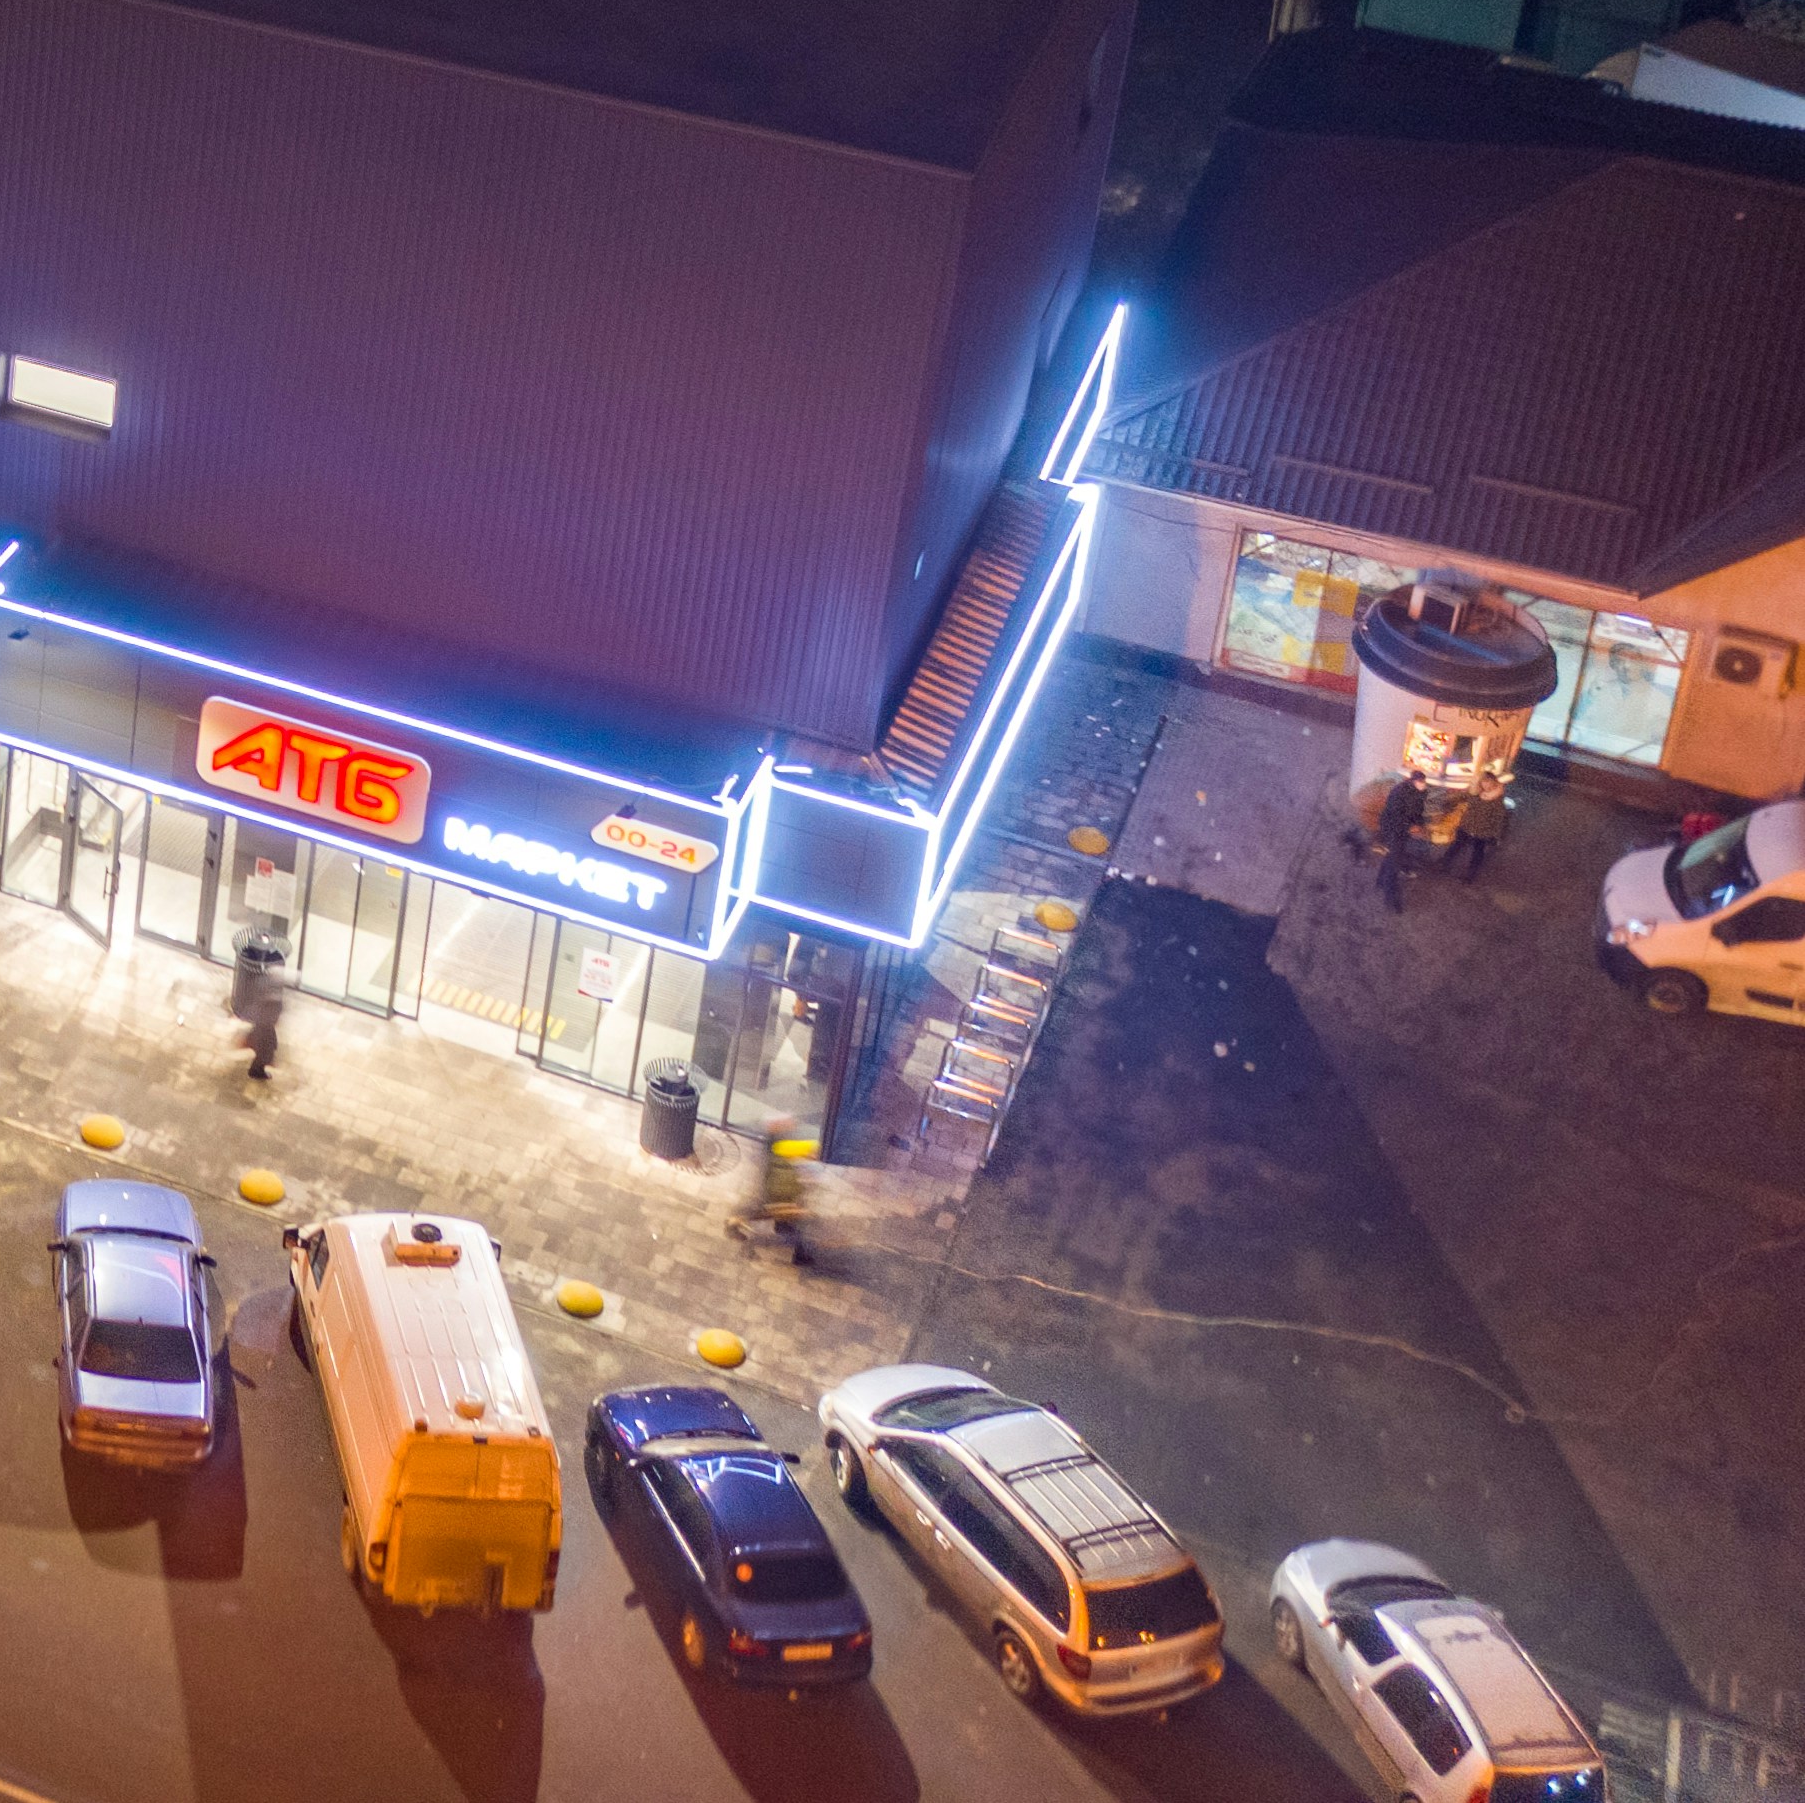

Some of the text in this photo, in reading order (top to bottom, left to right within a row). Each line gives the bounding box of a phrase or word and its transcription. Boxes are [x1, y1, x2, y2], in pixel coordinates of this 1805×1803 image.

[212, 721, 415, 825] АТБ
[443, 816, 668, 911] МАРКЕТ
[605, 824, 697, 865] 00-24
